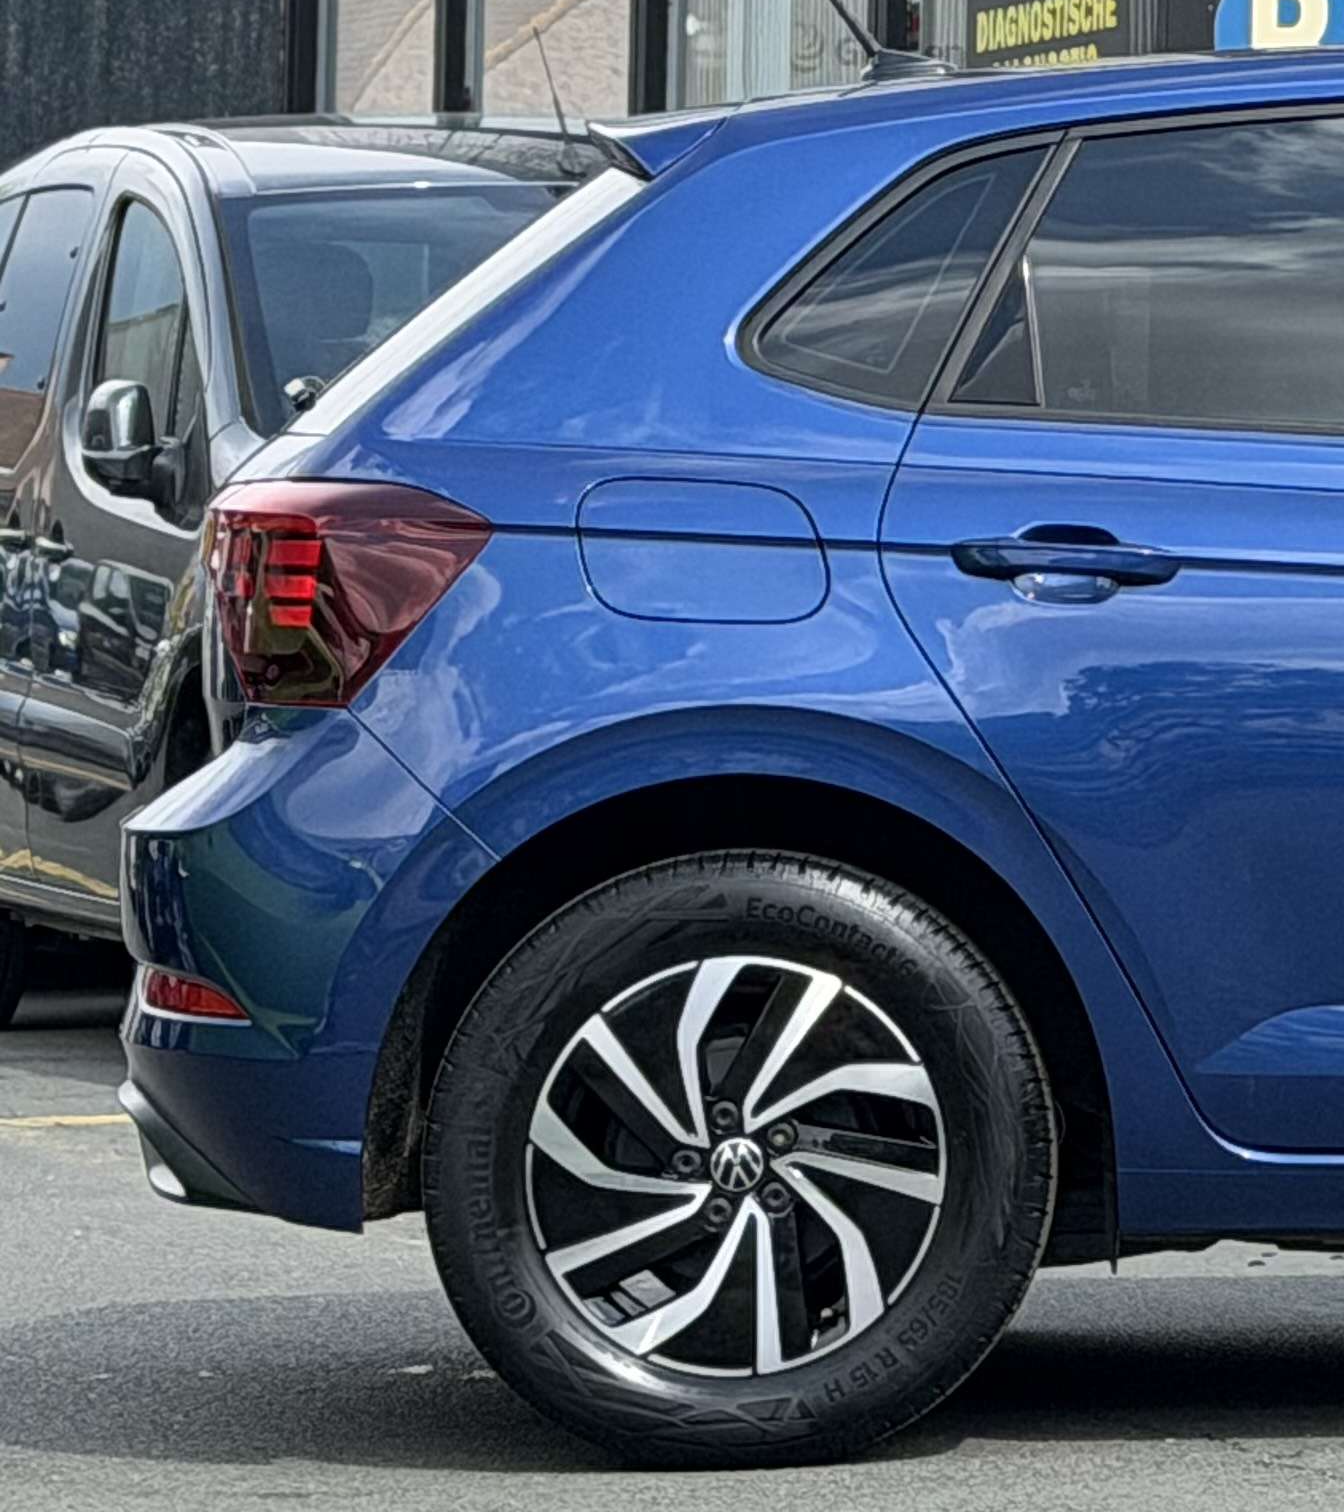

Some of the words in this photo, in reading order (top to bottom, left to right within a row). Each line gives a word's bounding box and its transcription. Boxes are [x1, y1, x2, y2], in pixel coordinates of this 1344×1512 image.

[746, 897, 898, 960] EcoContact
[874, 1346, 899, 1370] R
[849, 1361, 879, 1389] 15
[823, 1377, 846, 1403] H
